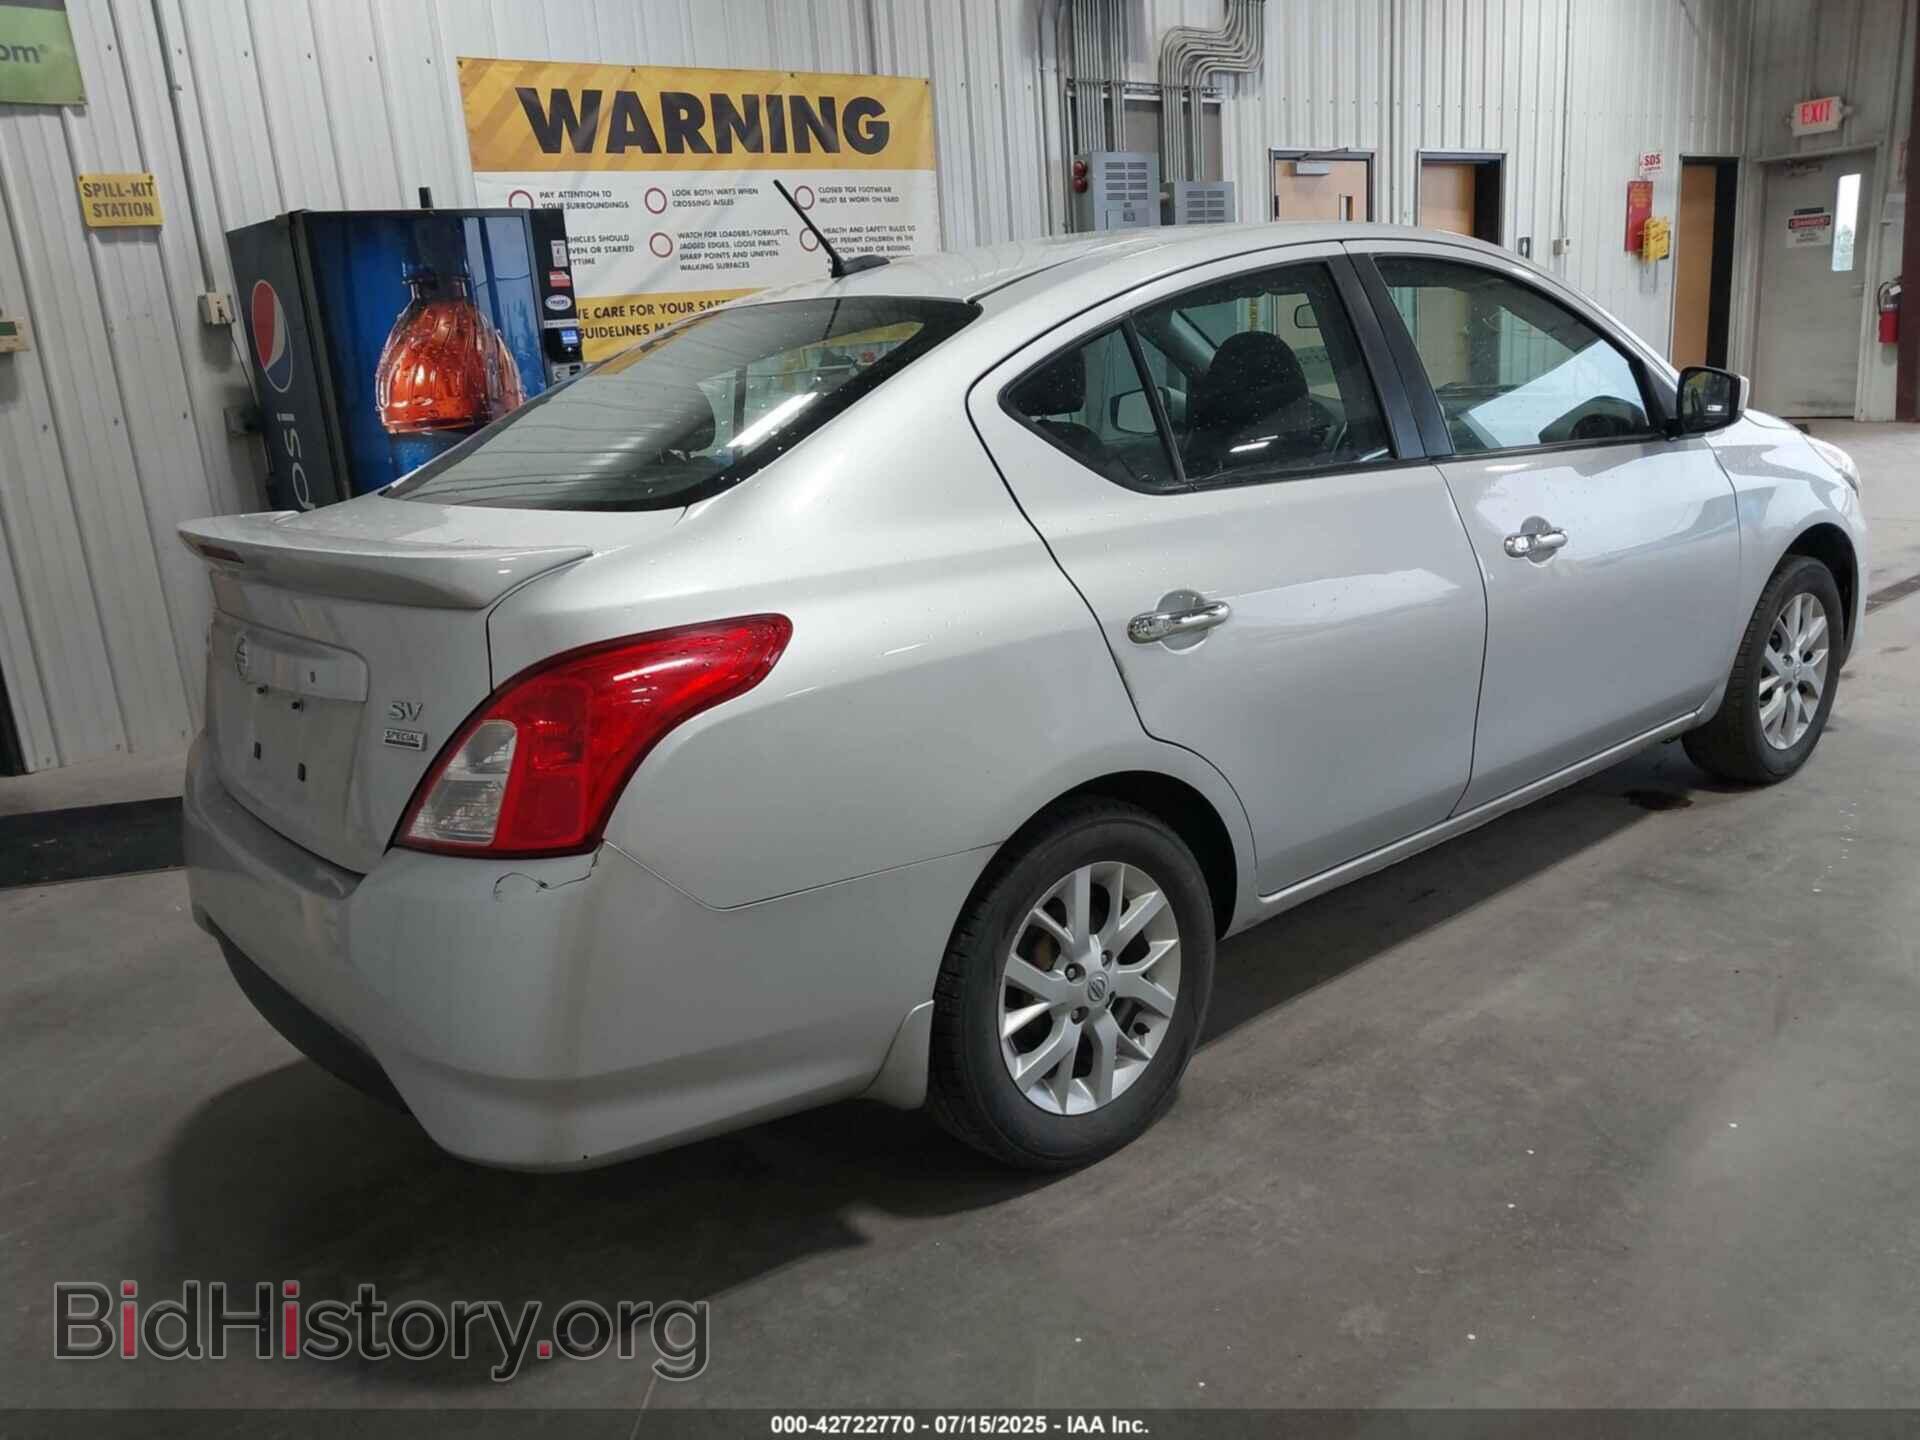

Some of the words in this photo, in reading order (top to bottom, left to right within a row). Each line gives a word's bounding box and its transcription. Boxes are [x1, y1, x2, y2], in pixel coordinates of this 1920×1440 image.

[1801, 99, 1832, 125] EXIT
[515, 86, 891, 155] WARNING
[1644, 154, 1661, 166] SDS
[82, 182, 155, 198] SPILL-KIT
[540, 190, 555, 199] PAY
[558, 190, 600, 199] ATTENTION
[602, 190, 612, 198] TO
[671, 189, 692, 198] LOOK
[694, 188, 714, 197] BOTH
[716, 188, 736, 197] WAYS
[738, 187, 759, 196] WHEN
[818, 186, 842, 194] CLOSED
[844, 186, 857, 194] TOE
[859, 186, 892, 194] FOOTWEAR
[672, 199, 711, 208] CROSSING
[713, 199, 735, 207] AISLES
[819, 196, 838, 204] MUST
[883, 195, 900, 203] YARD
[93, 202, 154, 217] STATION
[566, 201, 630, 210] SURROUNDINGS
[823, 227, 848, 235] HEALTH
[849, 226, 864, 234] AND
[865, 225, 888, 233] SAFETY
[889, 225, 906, 233] RULES
[598, 234, 630, 242] SHOULD
[678, 231, 702, 241] WATCH
[704, 231, 718, 240] FOR
[840, 236, 863, 244] PERMIT
[864, 235, 895, 243] CHILDREN
[590, 246, 602, 254] OR
[604, 245, 635, 254] STARTED
[680, 243, 706, 251] JAGGED
[734, 241, 757, 249] LOOSE
[680, 253, 702, 262] SHARP
[704, 252, 731, 261] POINTS
[732, 251, 748, 260] AND
[750, 250, 779, 259] UNEVEN
[680, 263, 714, 272] WALKING
[716, 261, 751, 270] SURFACES
[593, 306, 625, 319] CARE
[630, 304, 656, 317] FOR
[660, 301, 695, 315] YOUR
[388, 701, 424, 722] SV
[385, 729, 419, 743] SPECIAL
